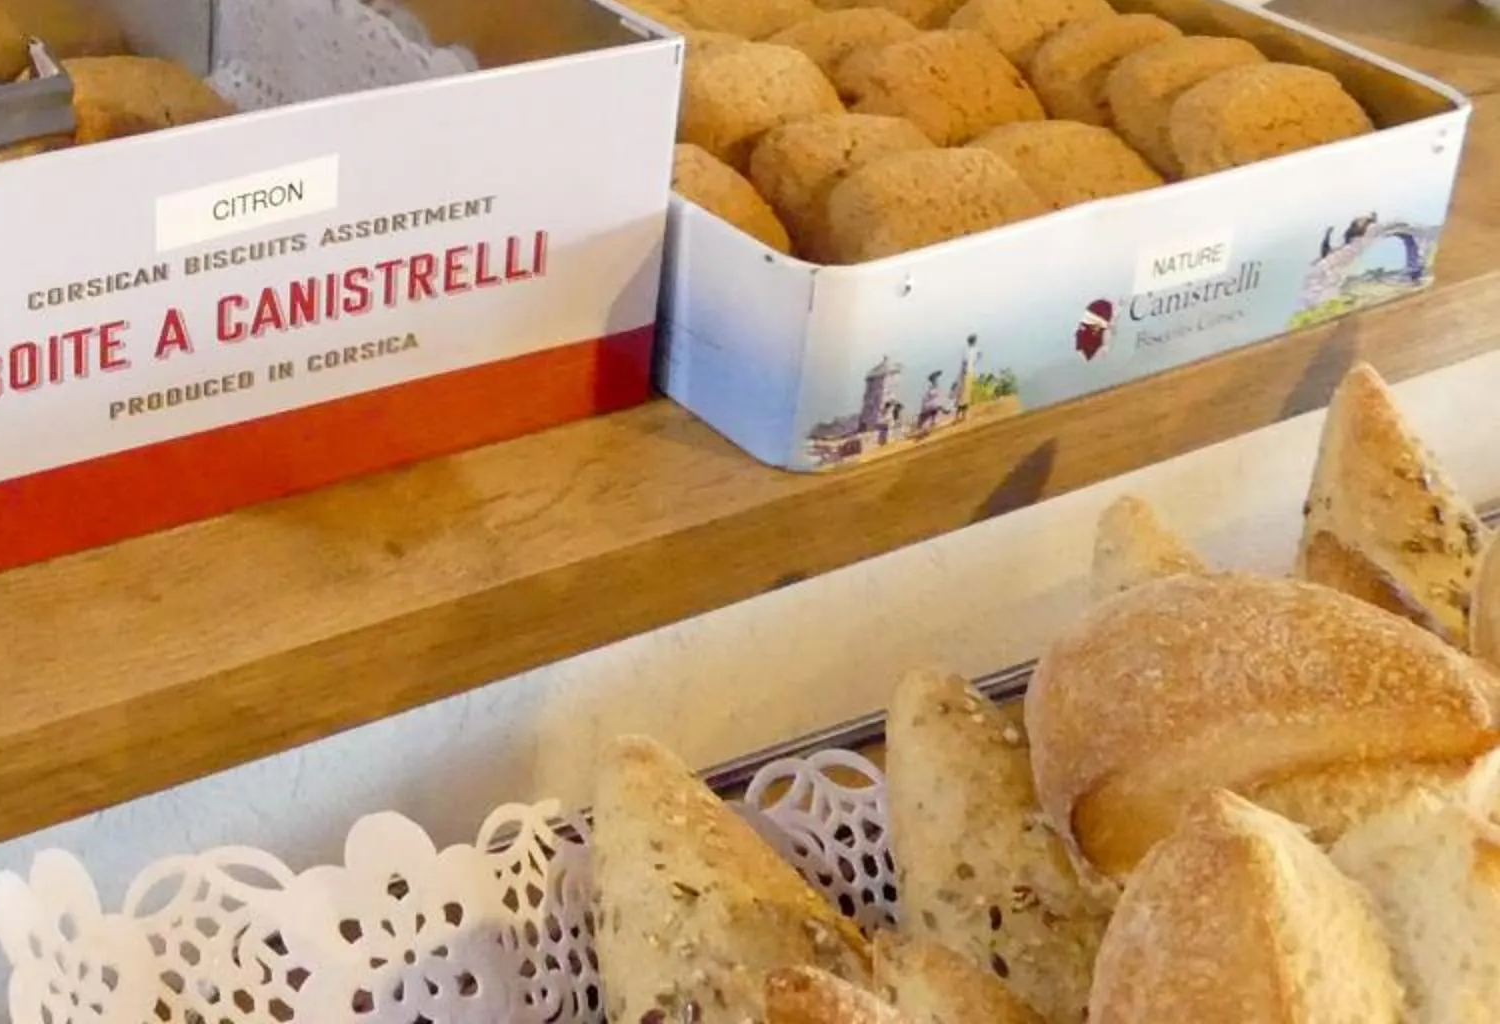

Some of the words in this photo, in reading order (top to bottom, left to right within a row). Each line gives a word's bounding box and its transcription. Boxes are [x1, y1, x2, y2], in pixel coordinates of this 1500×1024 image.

[212, 181, 304, 222] CITRON
[27, 262, 169, 311] CORSICAN
[184, 232, 308, 277] BISCUITS
[320, 195, 498, 247] ASSORTMENT
[1129, 260, 1263, 321] Canistrelli
[1153, 243, 1224, 276] NATURE
[155, 307, 194, 360] A
[216, 229, 551, 344] CANISTRELLI
[109, 370, 255, 421] PRODUCED
[268, 359, 295, 382] IN
[307, 332, 420, 375] CORSICA
